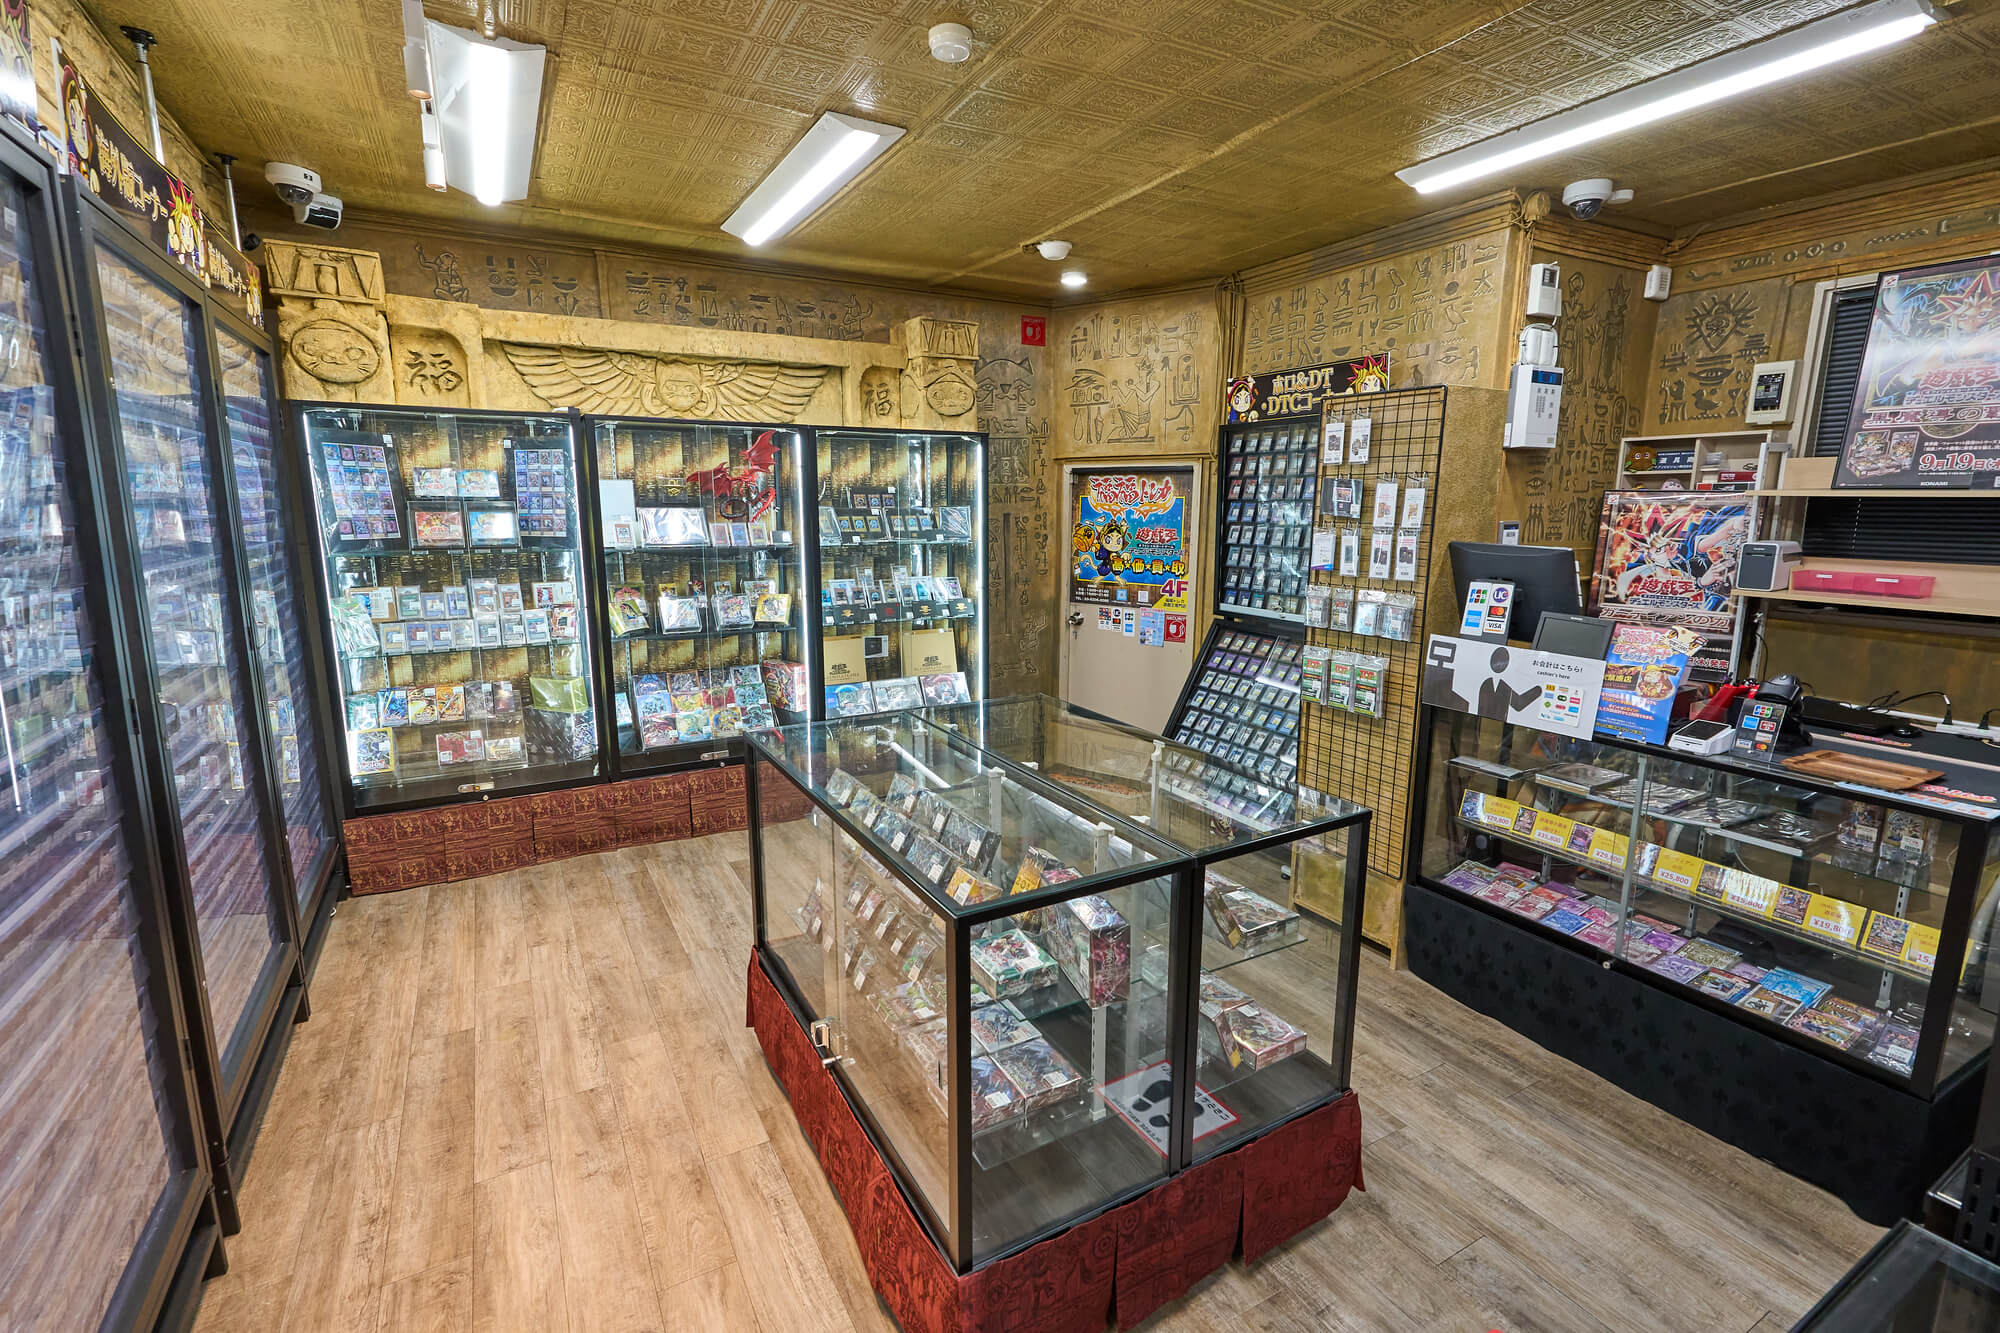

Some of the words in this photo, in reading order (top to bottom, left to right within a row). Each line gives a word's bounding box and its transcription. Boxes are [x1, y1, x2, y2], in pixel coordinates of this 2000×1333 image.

[1160, 578, 1189, 598] 4F
[1640, 578, 1696, 595] 遊戯王
[1629, 597, 1703, 609] デュエルモンスターズ
[1532, 660, 1583, 673] お会計はこちら!
[1660, 871, 1689, 885] ¥25,800
